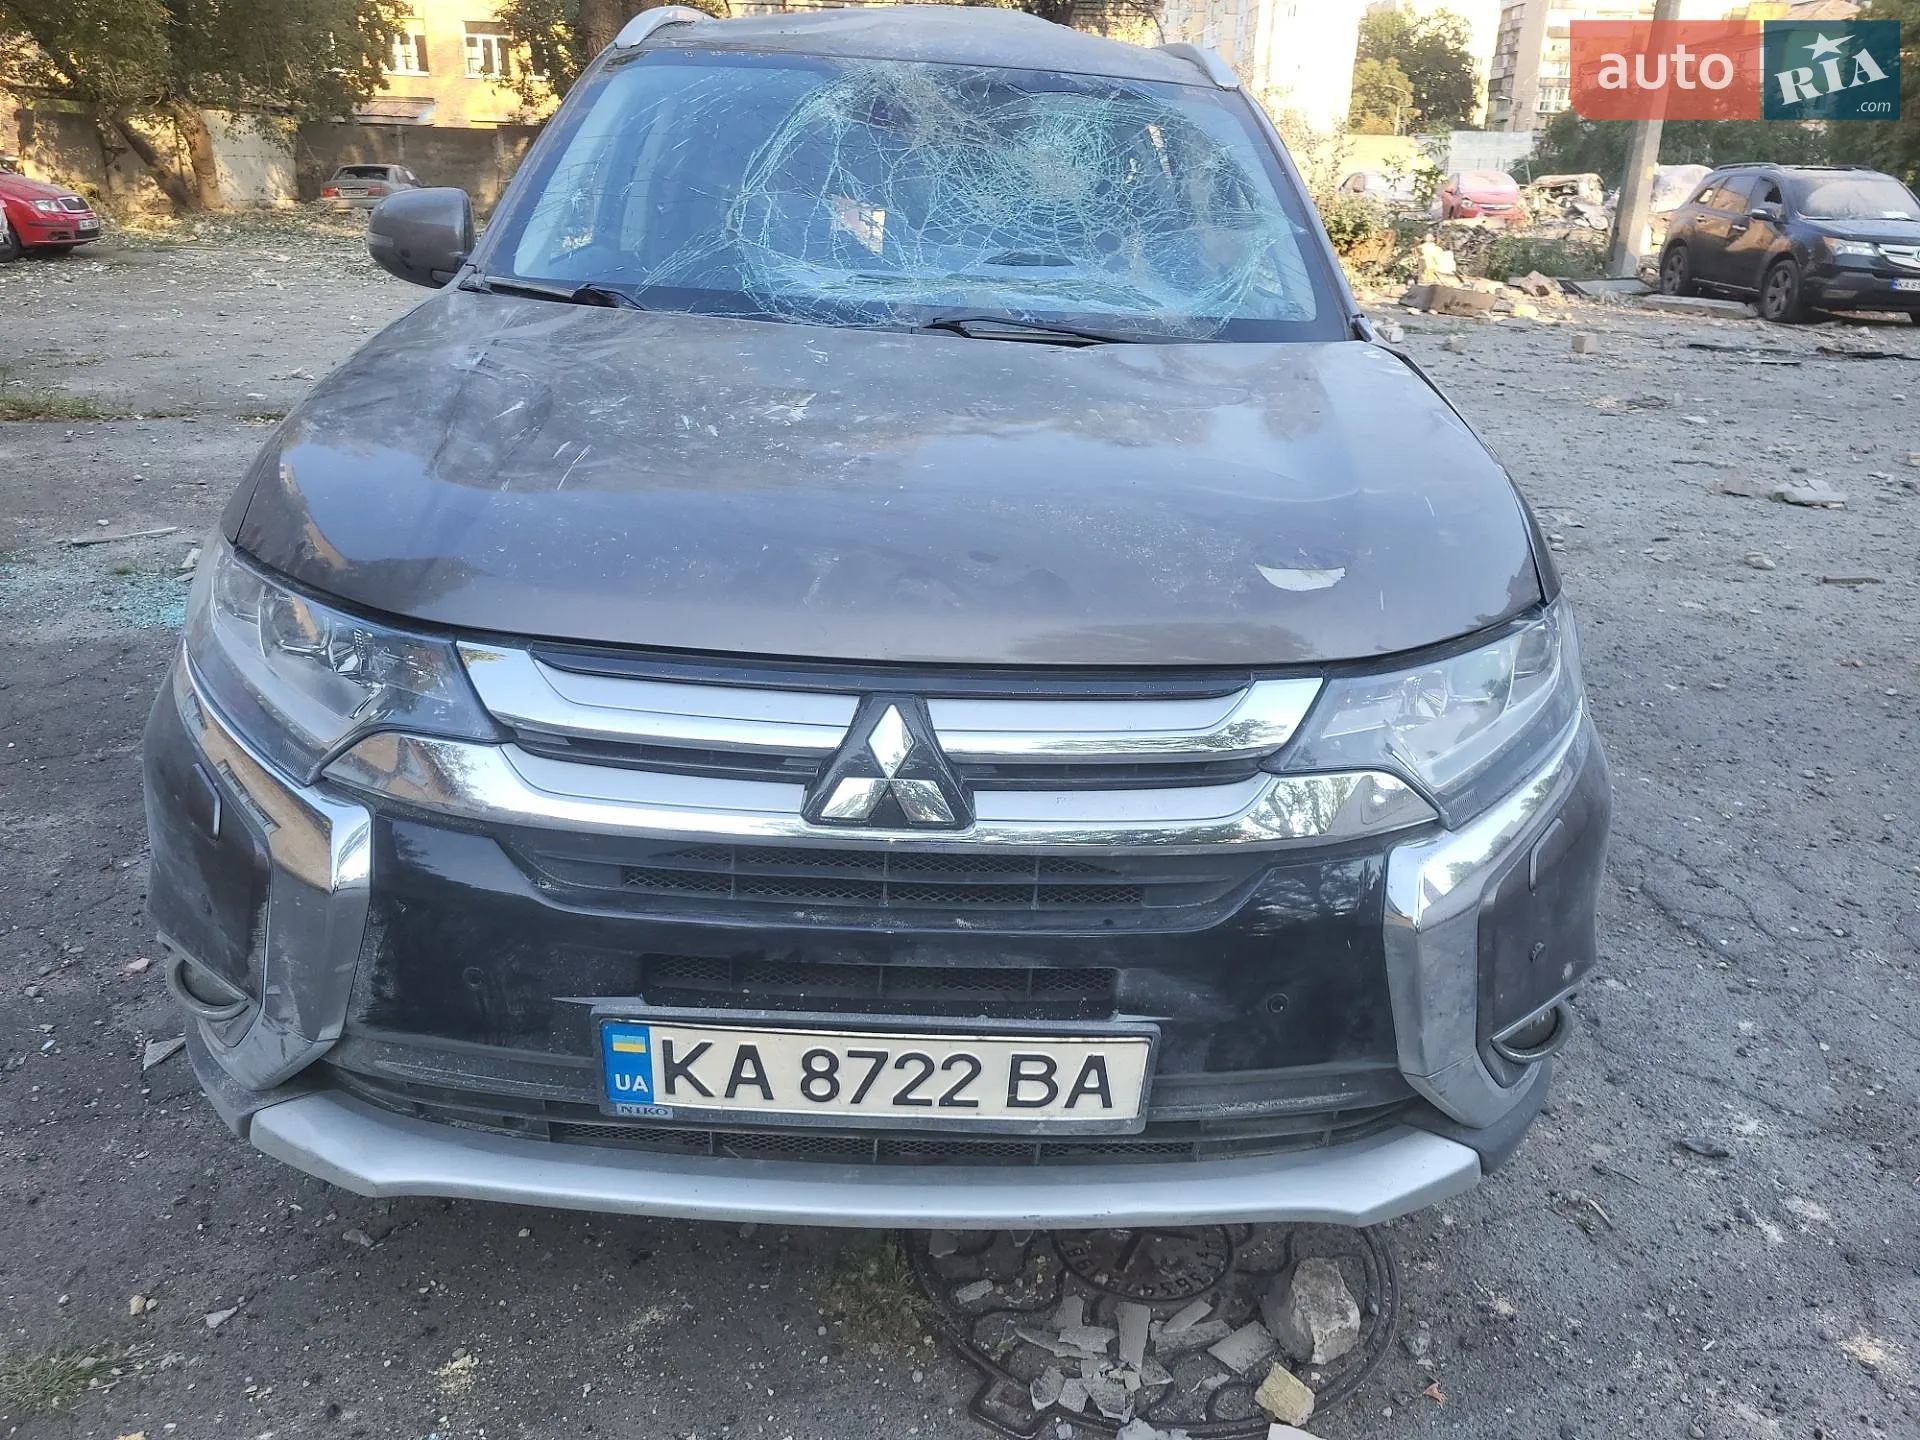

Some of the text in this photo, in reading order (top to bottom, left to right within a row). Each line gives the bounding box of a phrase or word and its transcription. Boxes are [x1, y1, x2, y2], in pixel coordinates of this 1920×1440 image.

[614, 1073, 649, 1093] UA
[662, 1039, 1114, 1109] KA 8722 BA
[620, 1105, 669, 1116] NIKO
